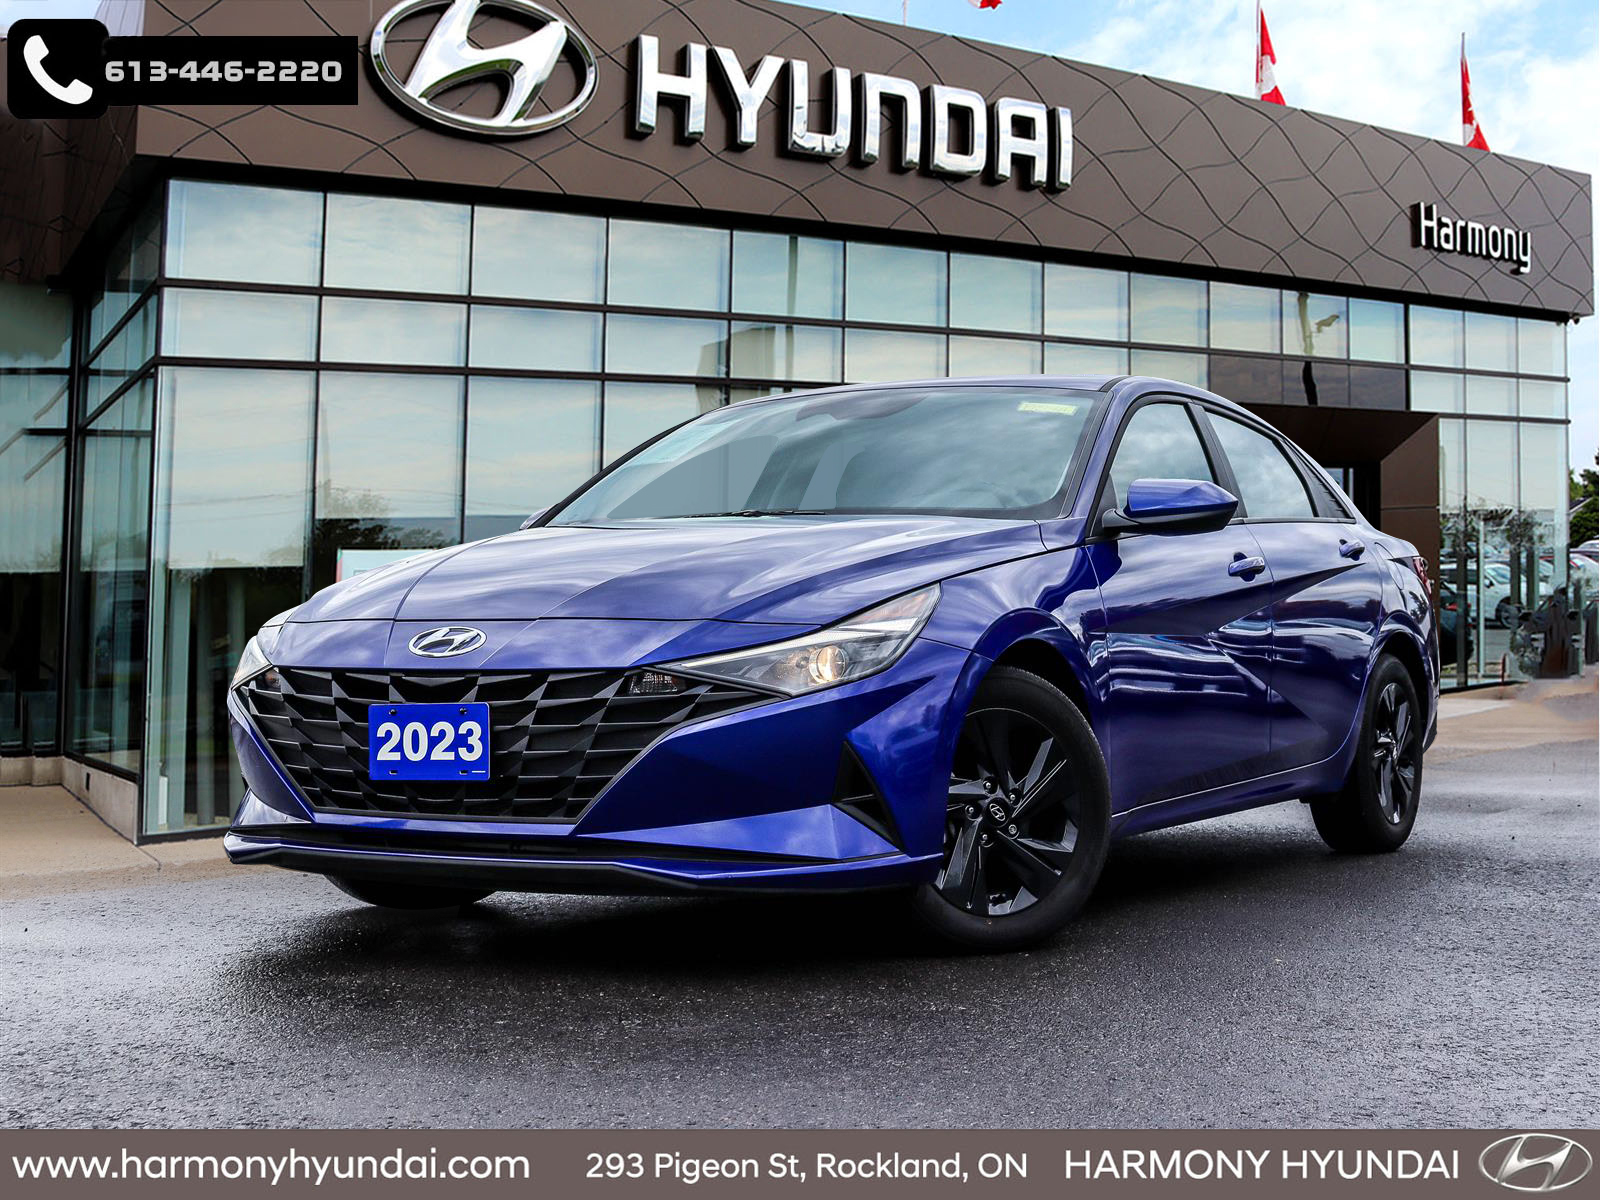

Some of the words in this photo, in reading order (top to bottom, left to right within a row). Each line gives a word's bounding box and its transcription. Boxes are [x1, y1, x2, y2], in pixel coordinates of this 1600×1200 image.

[635, 34, 1073, 191] HYUNDAI
[1419, 201, 1531, 274] Harmony
[376, 721, 483, 761] 2023
